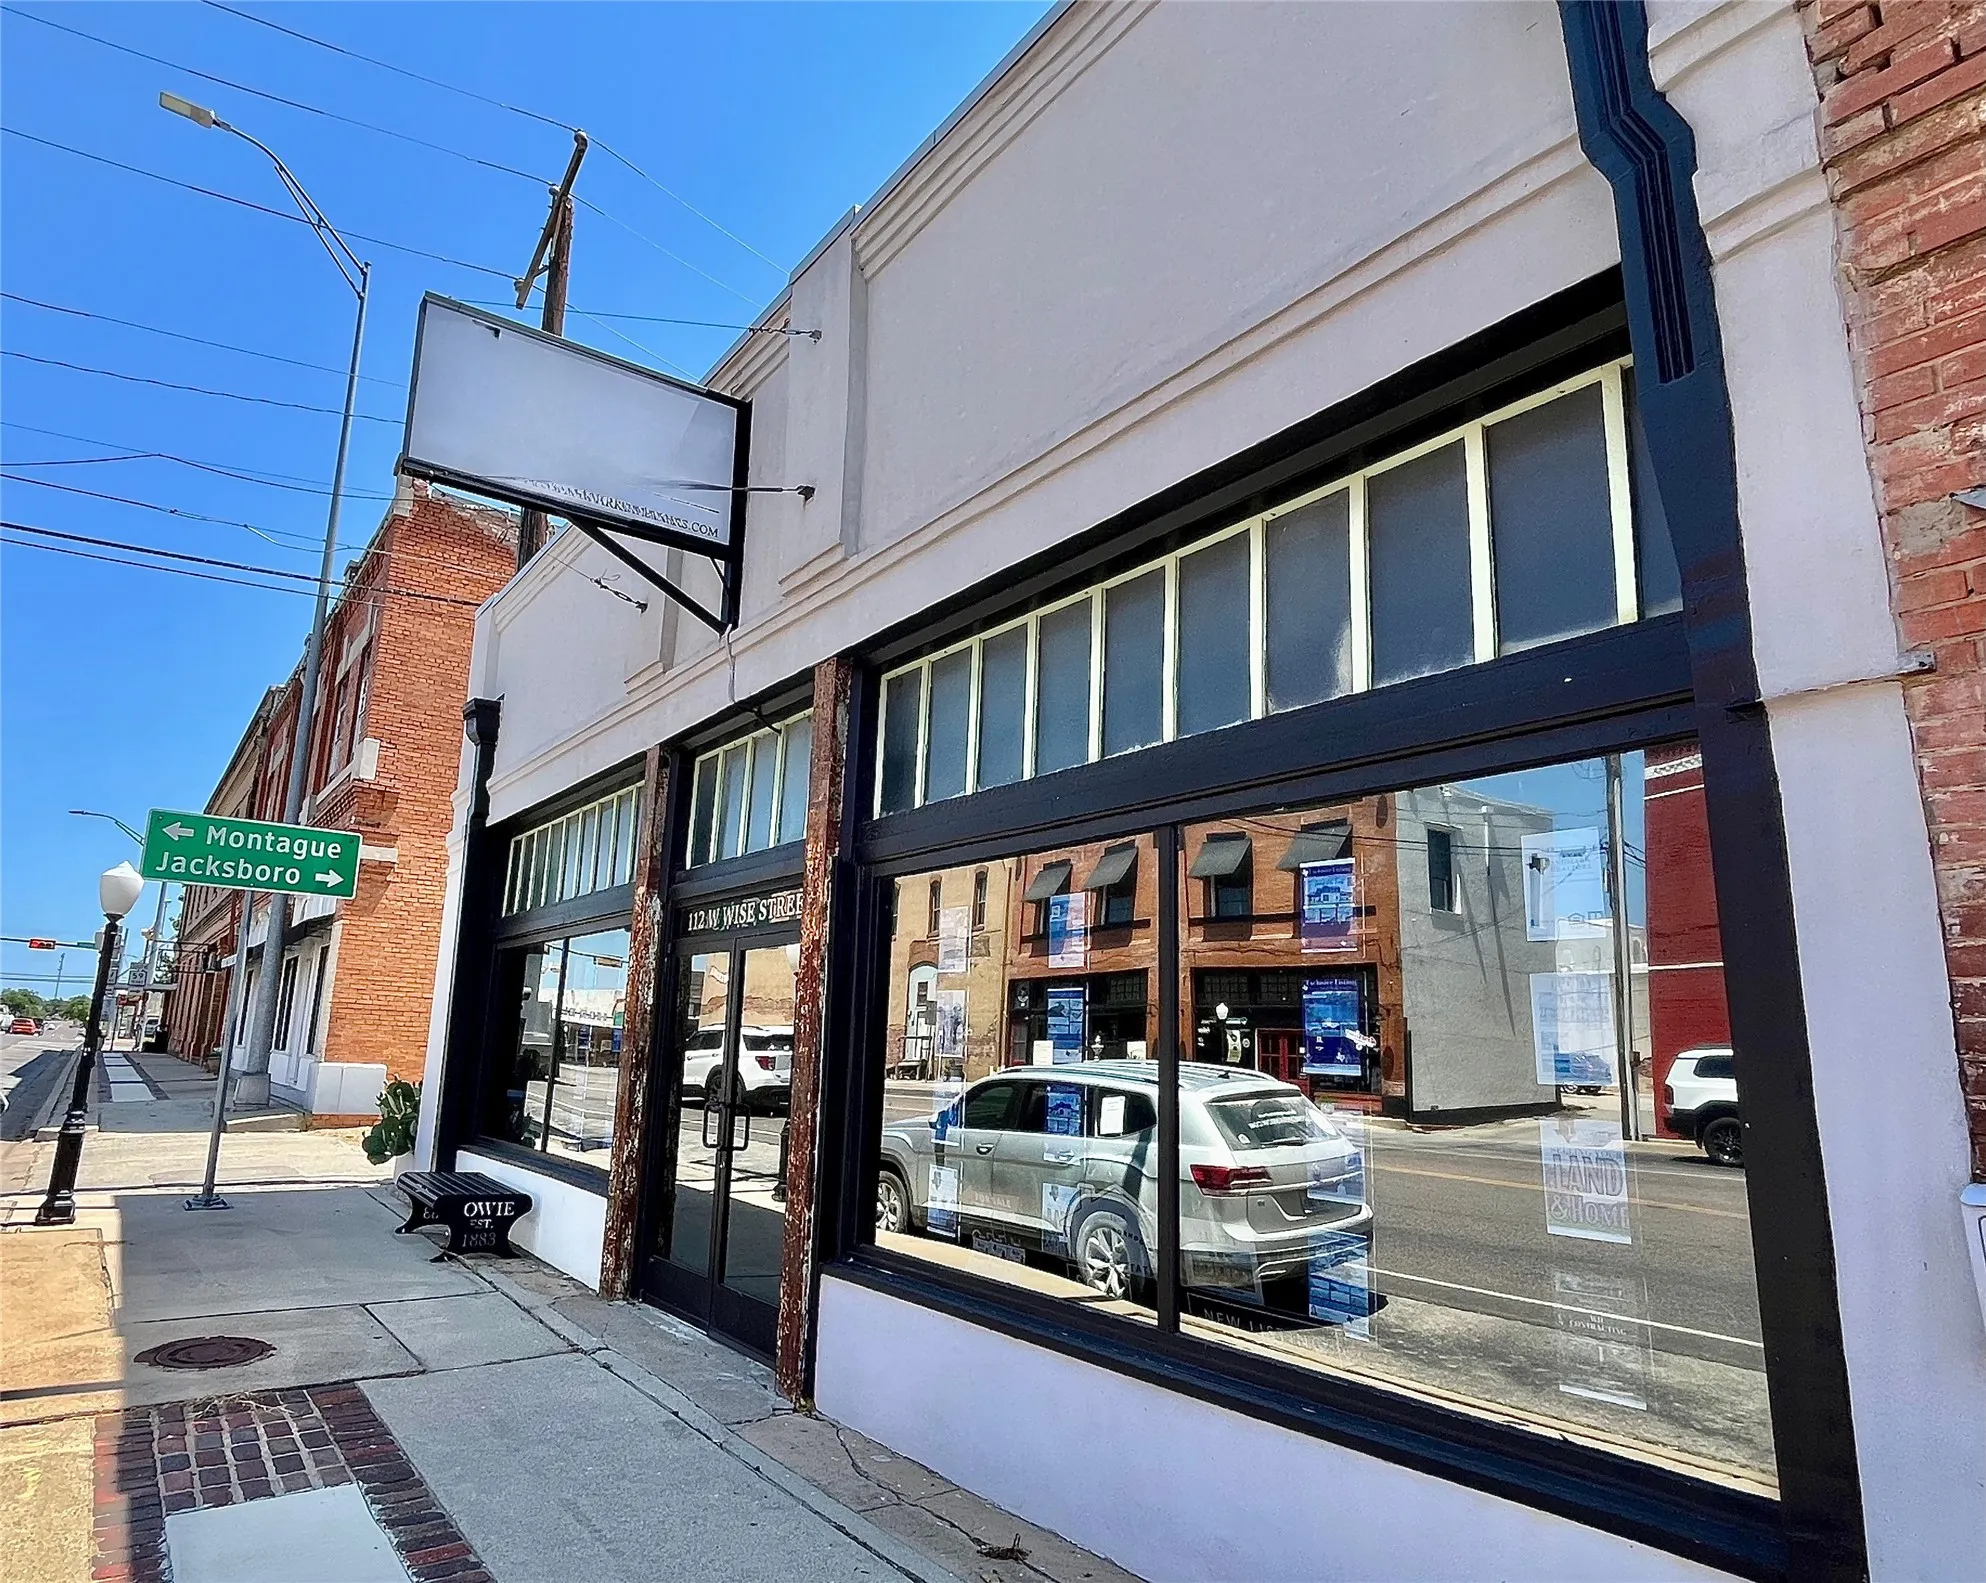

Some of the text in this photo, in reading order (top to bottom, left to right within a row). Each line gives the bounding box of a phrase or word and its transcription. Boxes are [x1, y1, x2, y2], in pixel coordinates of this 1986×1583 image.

[206, 825, 342, 861] Montague
[155, 852, 301, 885] Jacksboro
[688, 910, 705, 931] 112
[723, 901, 756, 926] WISE
[758, 893, 803, 921] STREE
[132, 972, 144, 980] 59
[1552, 1153, 1624, 1197] LAND
[1203, 1308, 1240, 1328] NEW
